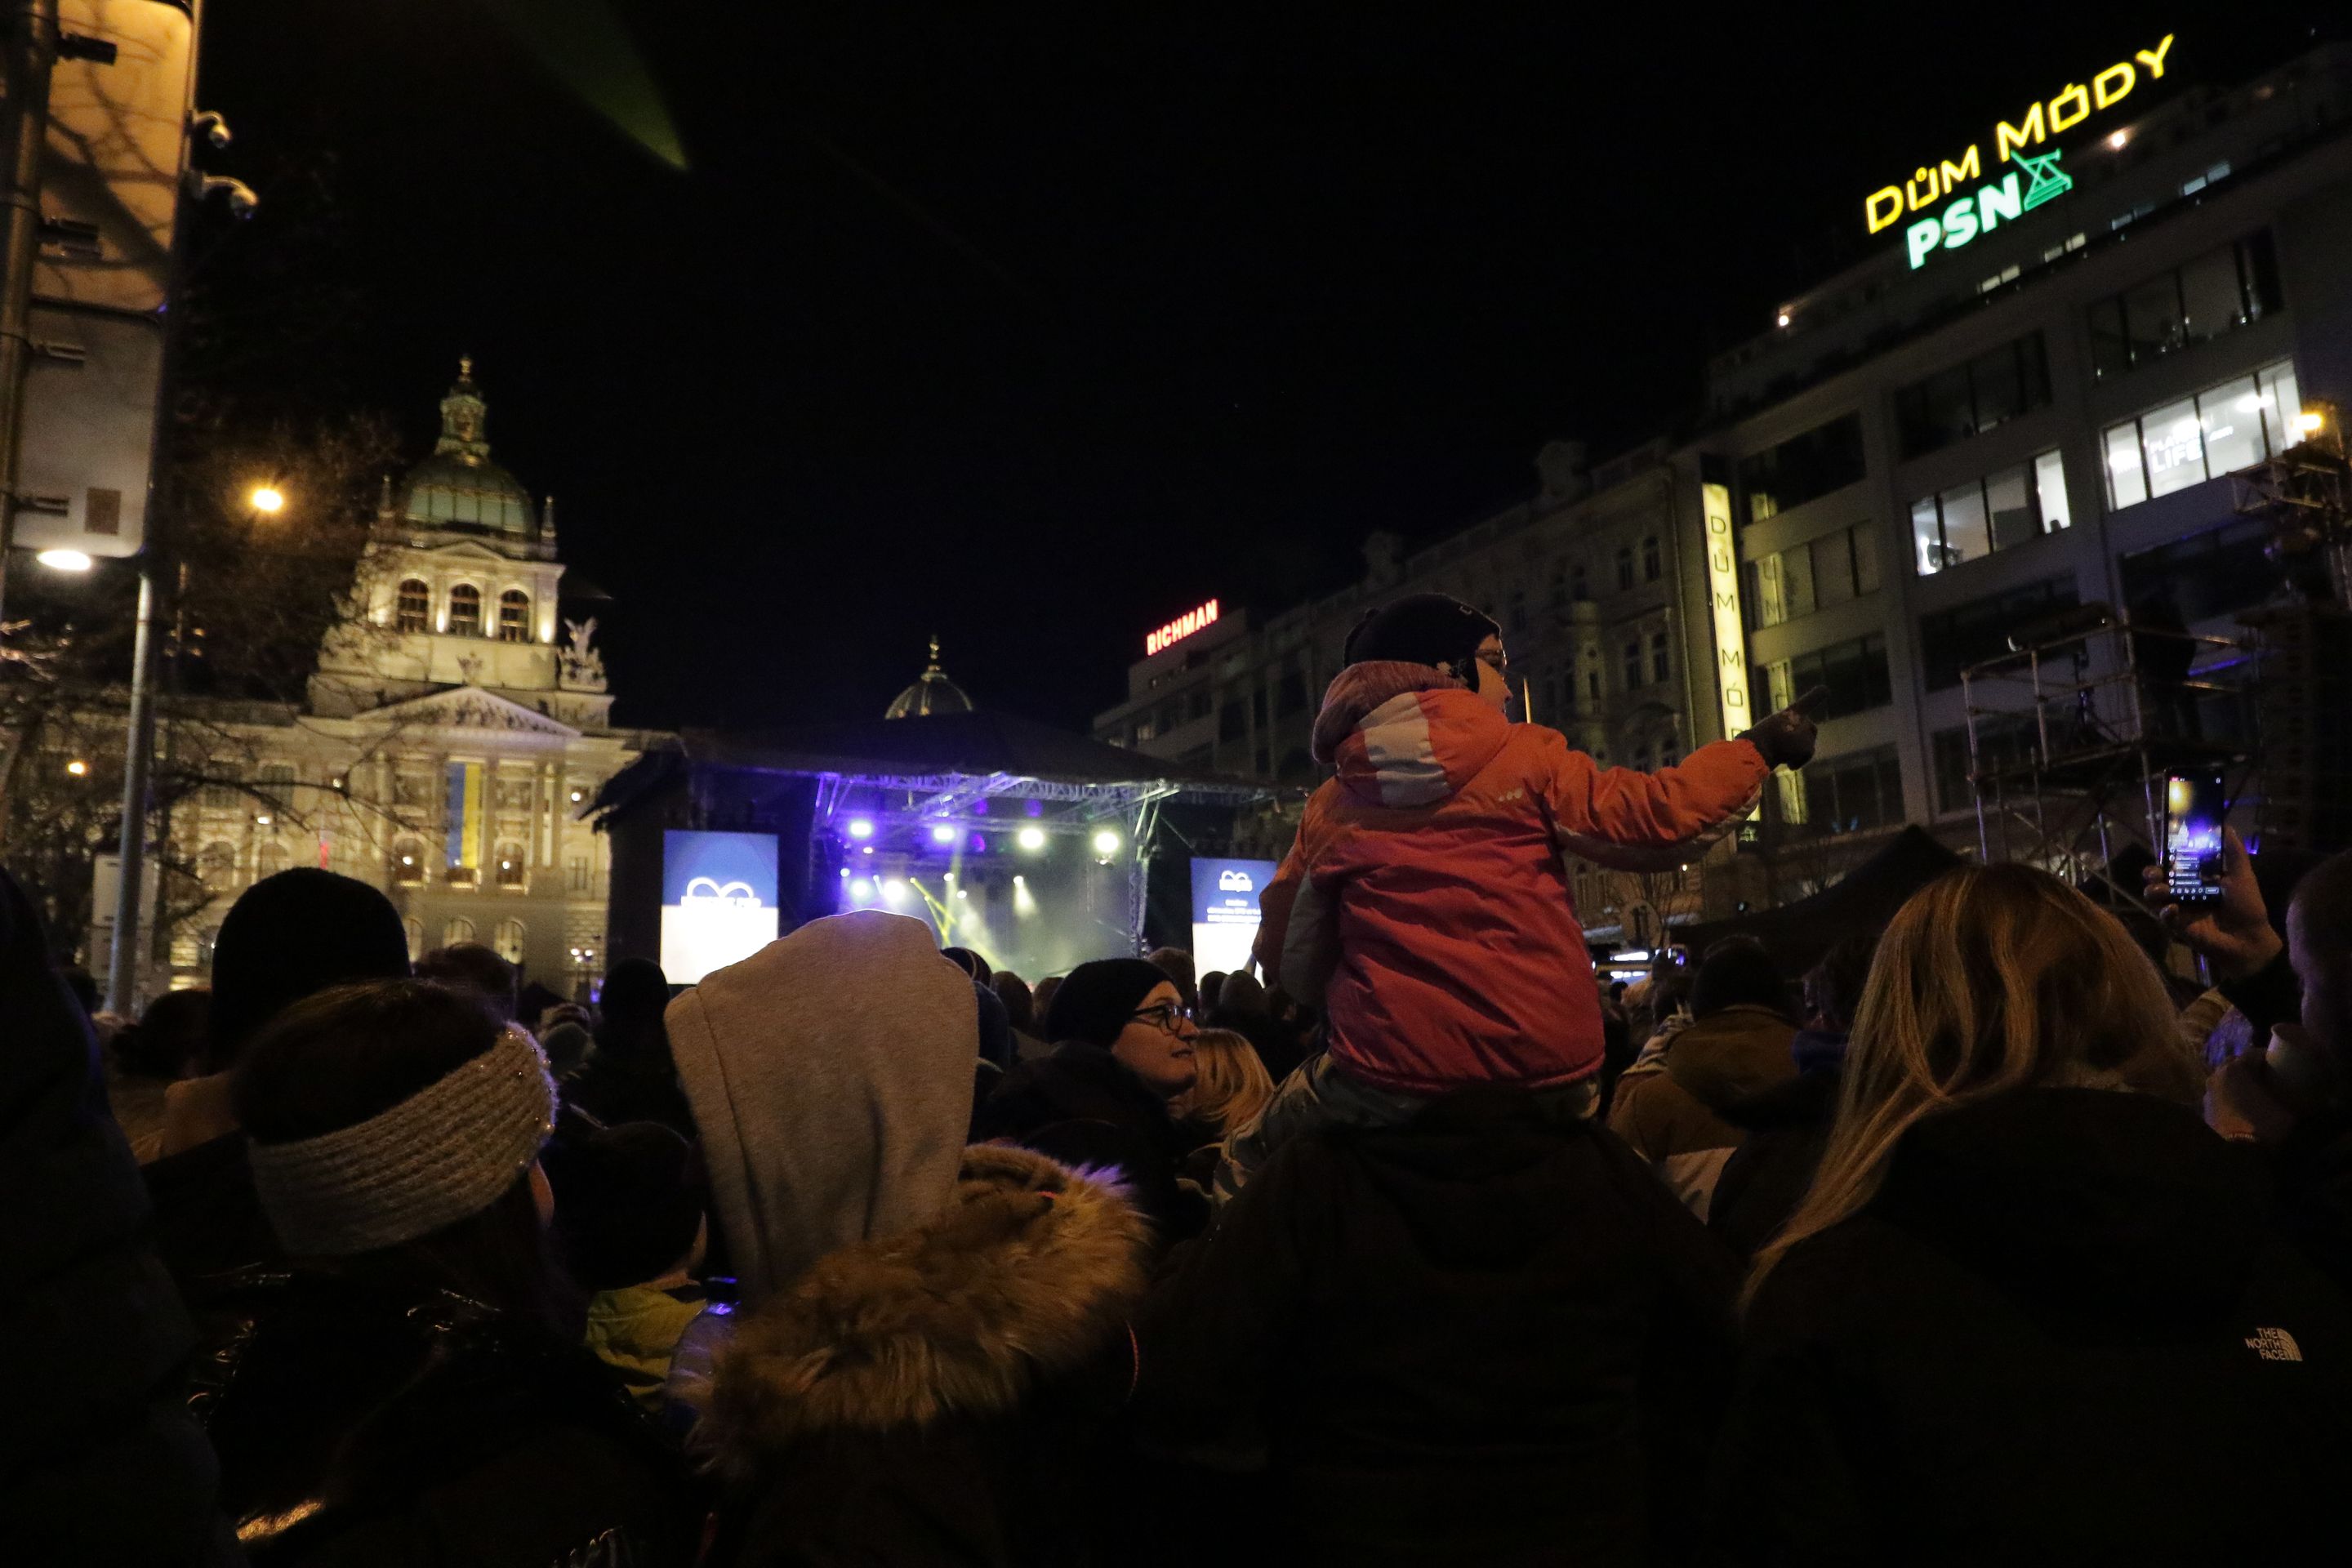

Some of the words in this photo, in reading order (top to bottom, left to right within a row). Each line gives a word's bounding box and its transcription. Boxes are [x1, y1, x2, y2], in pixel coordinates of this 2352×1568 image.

[1866, 144, 1981, 235] DŮM
[1995, 33, 2175, 163] MÓDY
[1906, 172, 2023, 270] PSN
[1147, 598, 1218, 657] RICHMAN
[2243, 1338, 2282, 1350] NORTH
[2256, 1327, 2278, 1339] THE
[2259, 1348, 2287, 1361] FACE
